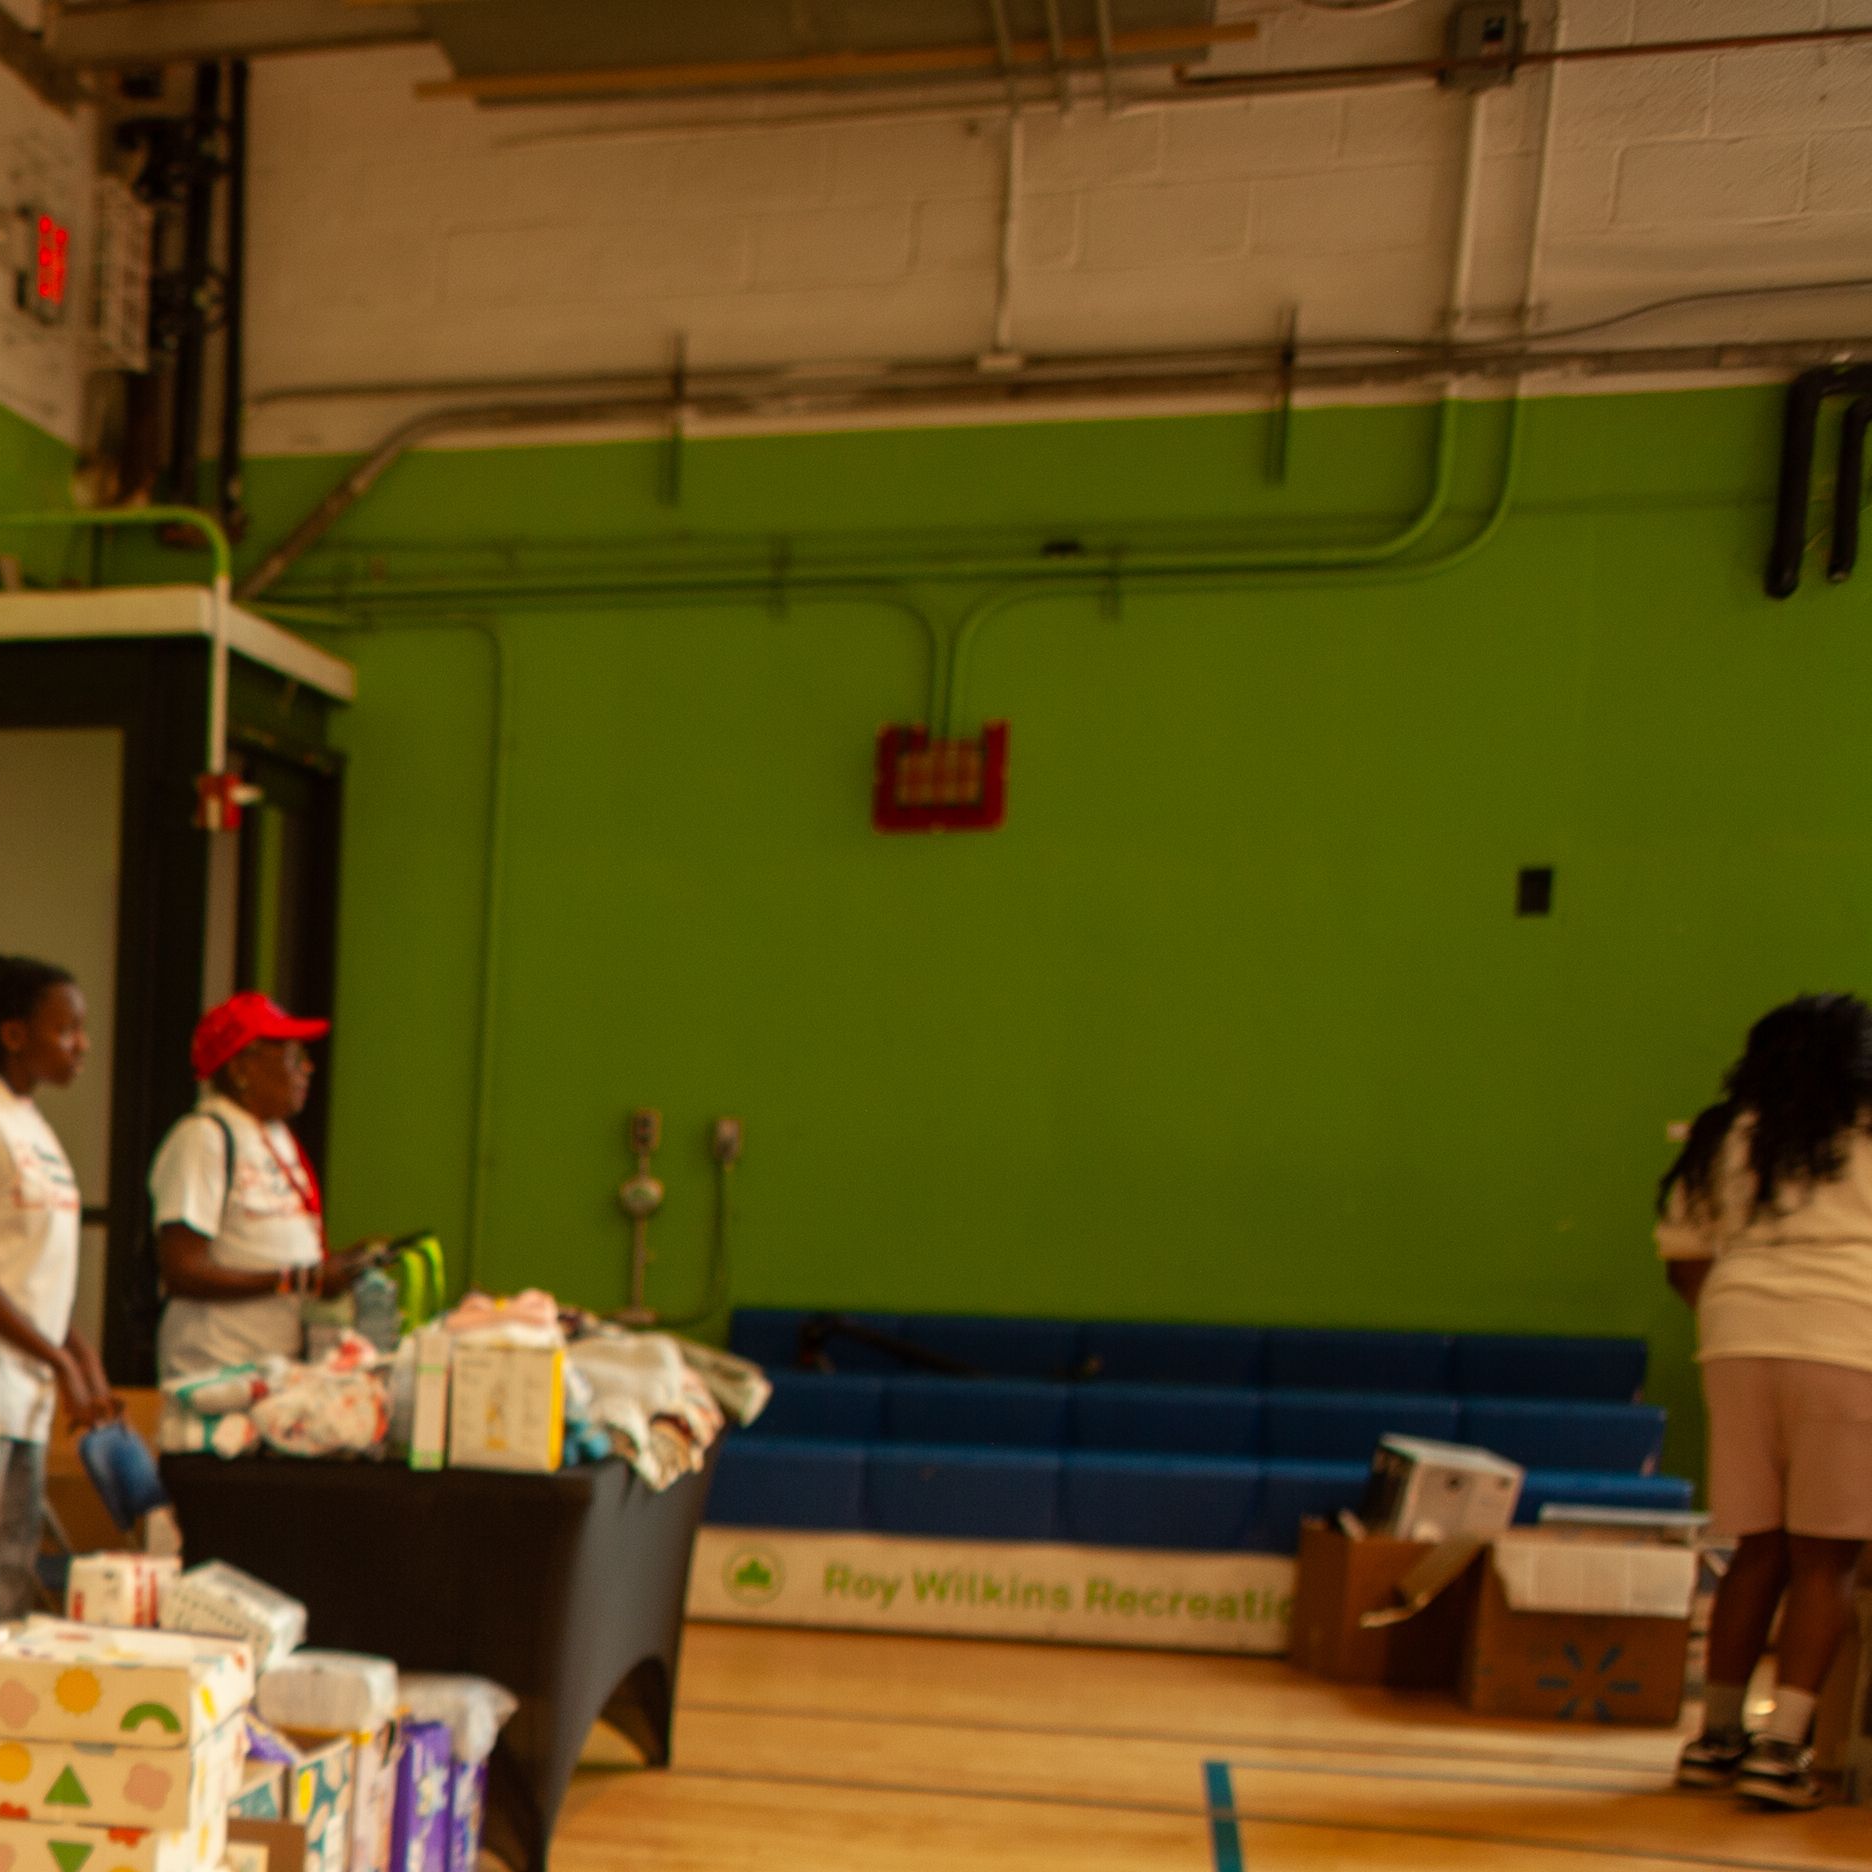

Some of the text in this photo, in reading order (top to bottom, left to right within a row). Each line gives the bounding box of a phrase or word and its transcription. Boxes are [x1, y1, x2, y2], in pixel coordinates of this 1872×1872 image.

[823, 1561, 1294, 1623] Roy Wilkins Recreatio
